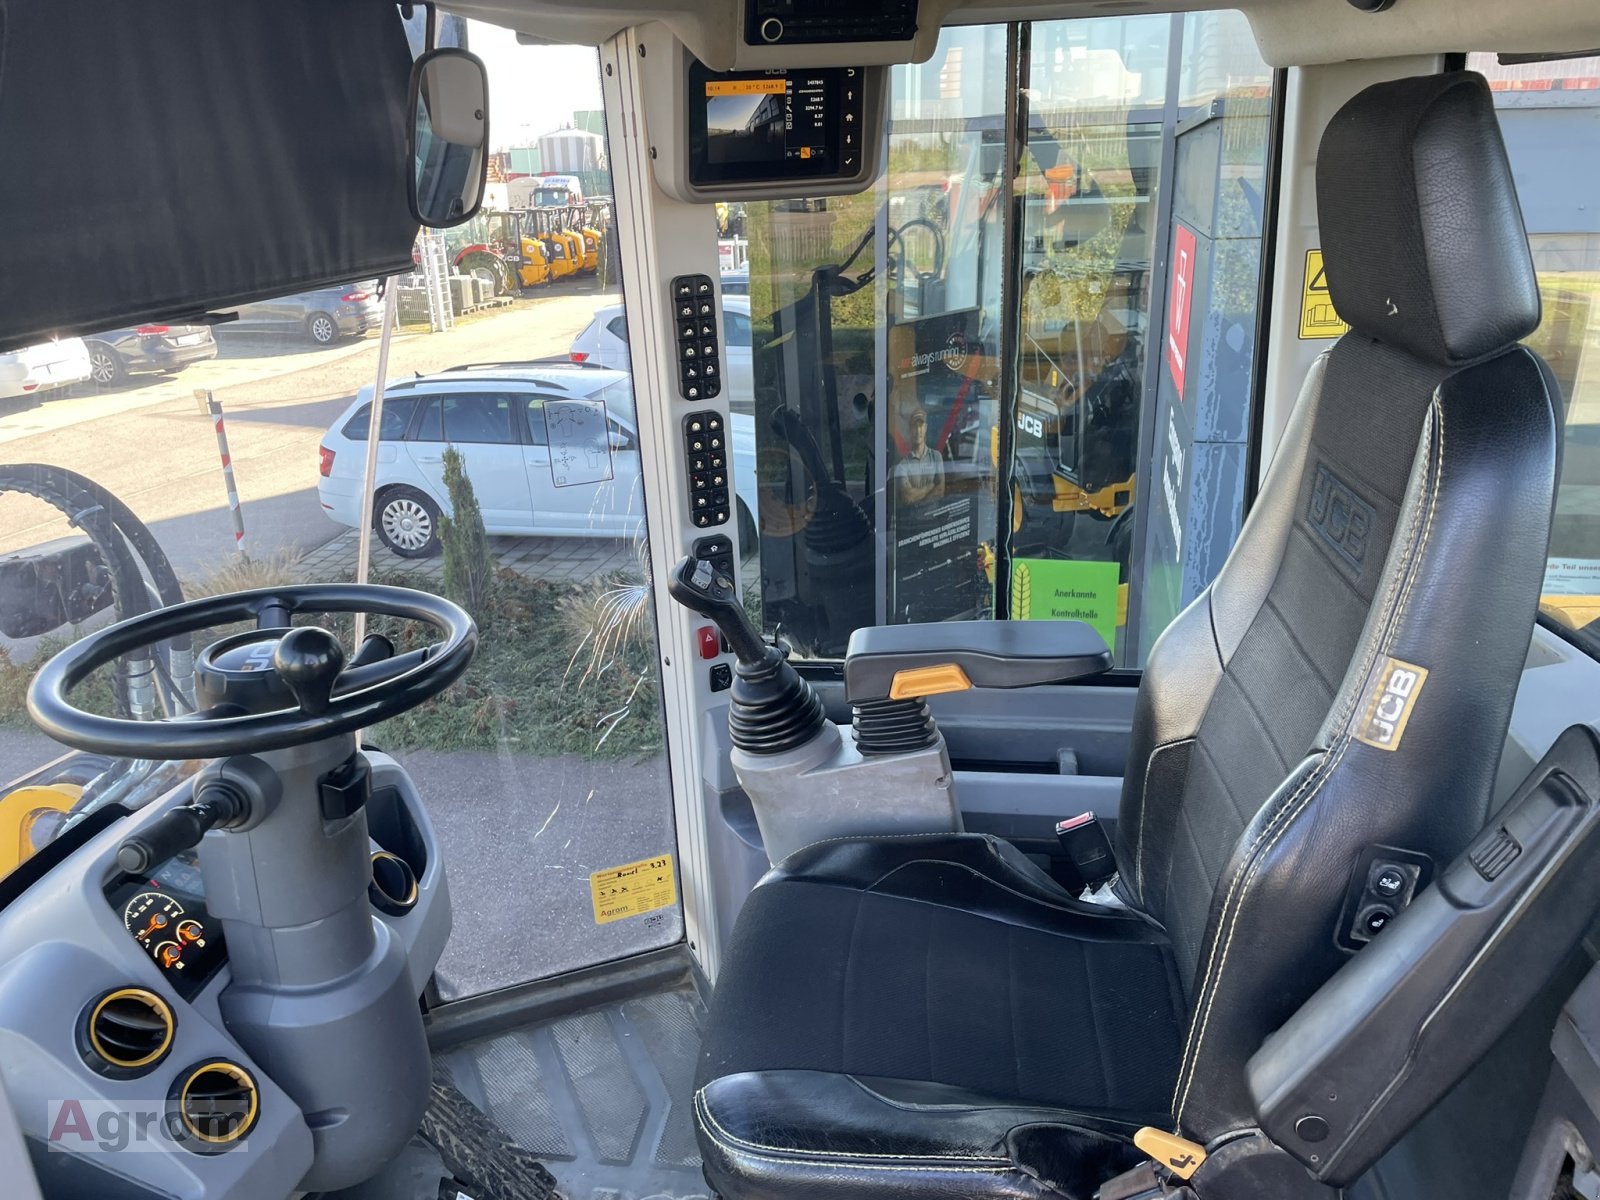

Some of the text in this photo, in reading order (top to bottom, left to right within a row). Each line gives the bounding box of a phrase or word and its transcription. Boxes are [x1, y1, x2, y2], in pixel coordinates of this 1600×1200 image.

[1017, 412, 1043, 439] JCB
[1308, 469, 1371, 564] JCB
[1054, 588, 1097, 599] Anerkannte
[1051, 608, 1098, 619] Kontrollstelle
[1371, 668, 1417, 743] JCB
[600, 905, 629, 917] Agrom
